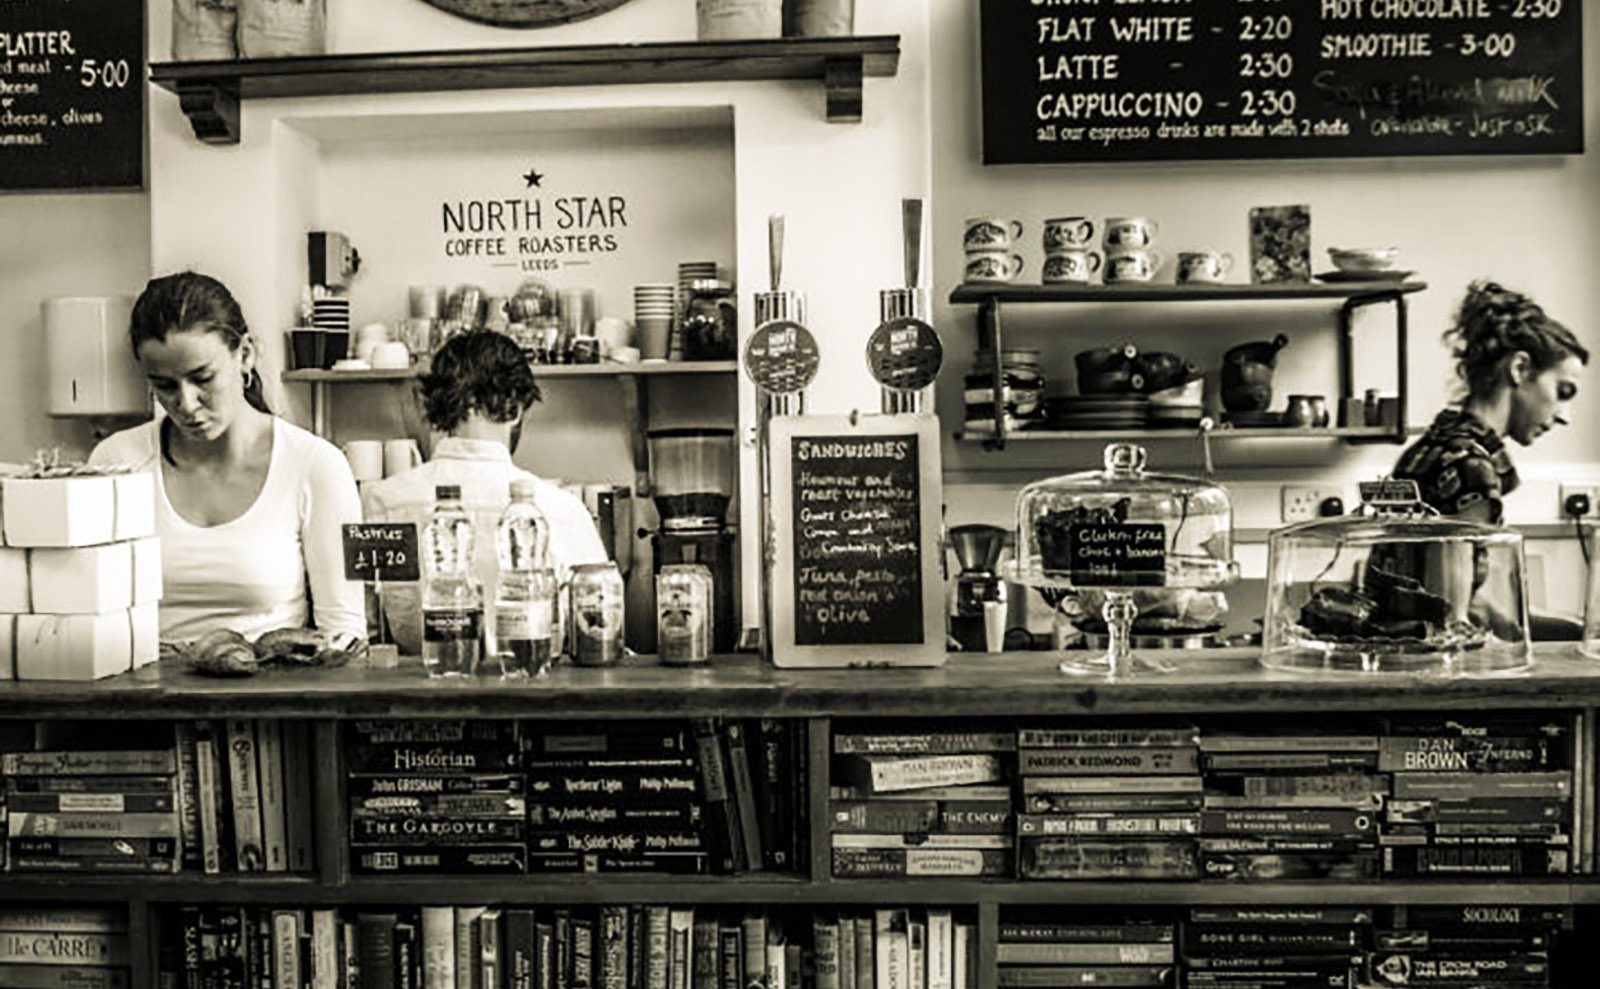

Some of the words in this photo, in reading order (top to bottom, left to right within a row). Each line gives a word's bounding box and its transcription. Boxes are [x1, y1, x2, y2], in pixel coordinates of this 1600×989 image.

[1321, 0, 1363, 19] HOT
[1370, 0, 1491, 19] CHOCOLATE
[1037, 17, 1096, 43] FLAT
[1110, 16, 1194, 42] WHITE
[1321, 33, 1432, 58] SMOOTHIE
[1038, 55, 1119, 80] LATTE
[1037, 91, 1203, 120] CAPPUCCINO
[62, 108, 103, 125] olives
[1036, 125, 1057, 141] all
[1088, 125, 1150, 147] espresso
[1156, 120, 1200, 138] drinks
[1203, 123, 1226, 138] are
[1230, 119, 1265, 138] made
[1268, 117, 1298, 137] with
[1300, 118, 1312, 137] 2
[442, 199, 542, 233] NORTH
[554, 196, 628, 230] STAR
[445, 236, 507, 257] COFFEE
[518, 233, 618, 255] ROASTERS
[521, 258, 560, 271] LEEDS
[798, 440, 908, 460] SANDWICHES
[1419, 738, 1455, 751] DAN
[394, 748, 477, 769] Historian
[1028, 756, 1076, 768] PATRICK
[1079, 756, 1142, 768] REDMOND
[1405, 751, 1469, 770] BROWN
[943, 811, 963, 823] THE
[967, 811, 1008, 823] ENEMY
[364, 820, 398, 834] THE
[403, 819, 497, 836] GARGOYLE
